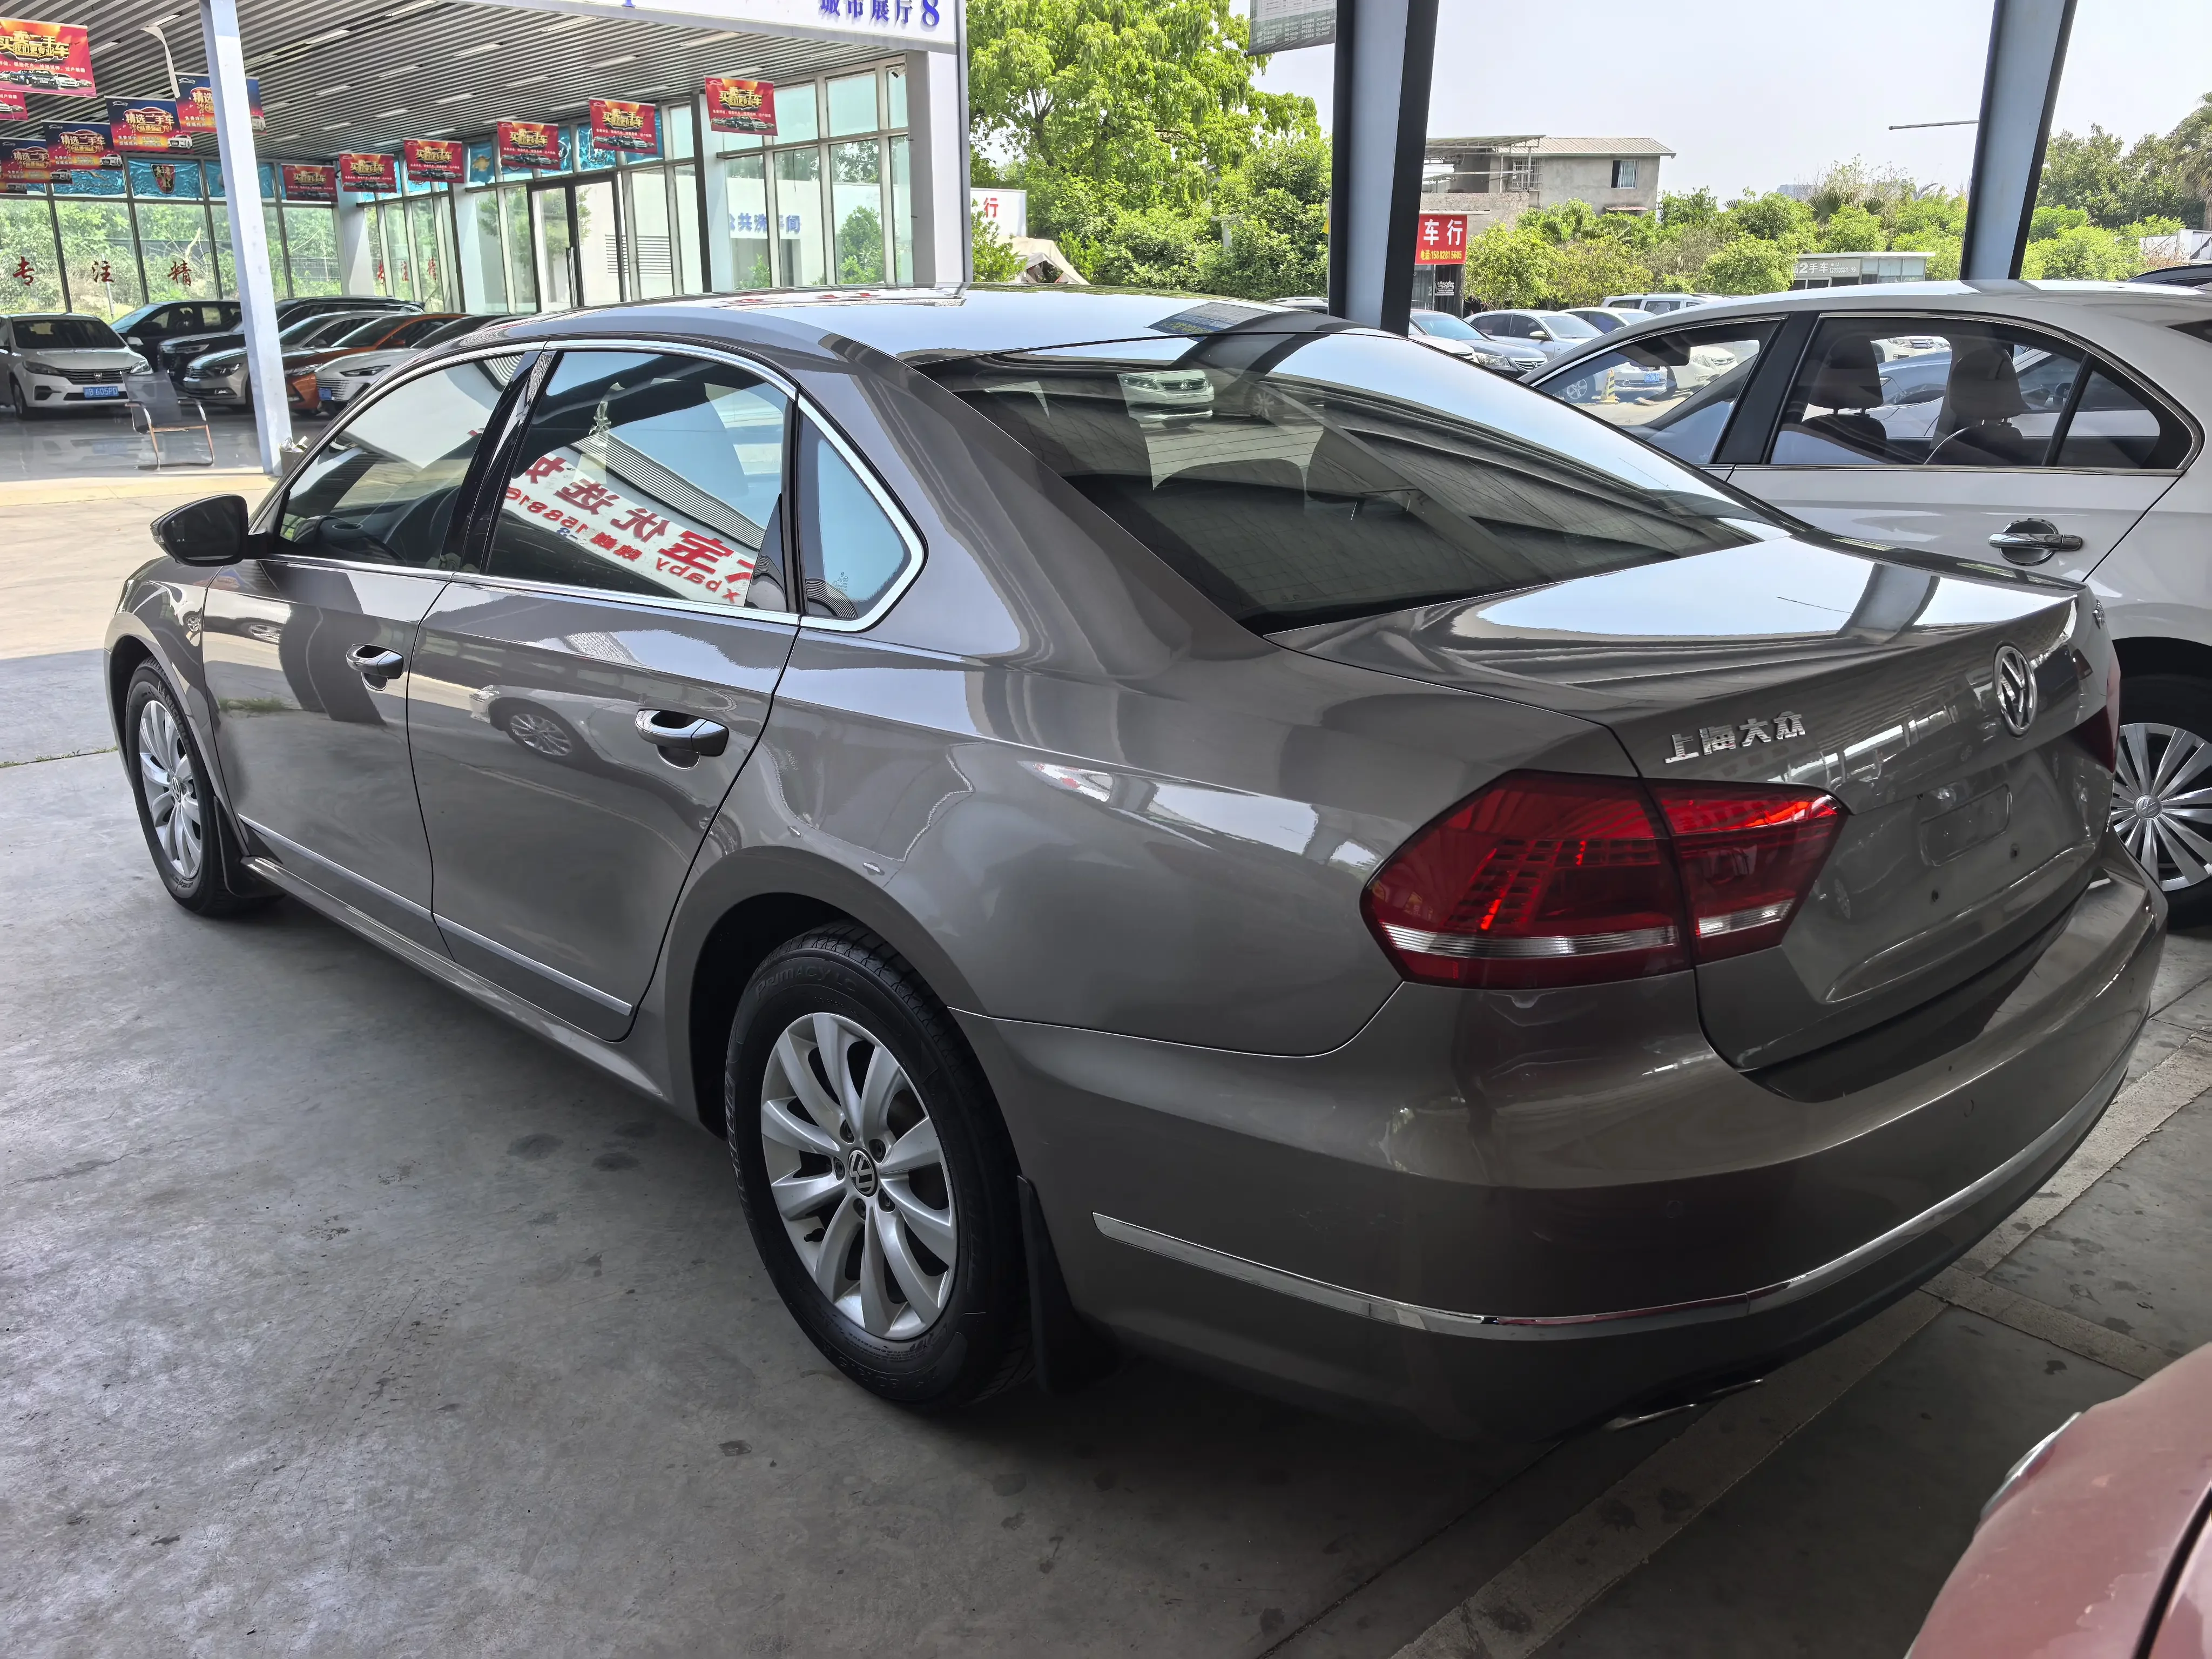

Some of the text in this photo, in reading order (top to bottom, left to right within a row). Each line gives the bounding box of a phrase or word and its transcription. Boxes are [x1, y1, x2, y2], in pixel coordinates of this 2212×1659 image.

[125, 112, 174, 125] 精选二手车
[60, 136, 105, 145] 精选二手车
[983, 197, 999, 218] 行
[1424, 219, 1463, 246] 车行
[1665, 711, 1806, 764] 上海大众
[756, 966, 831, 999] PRIMACY
